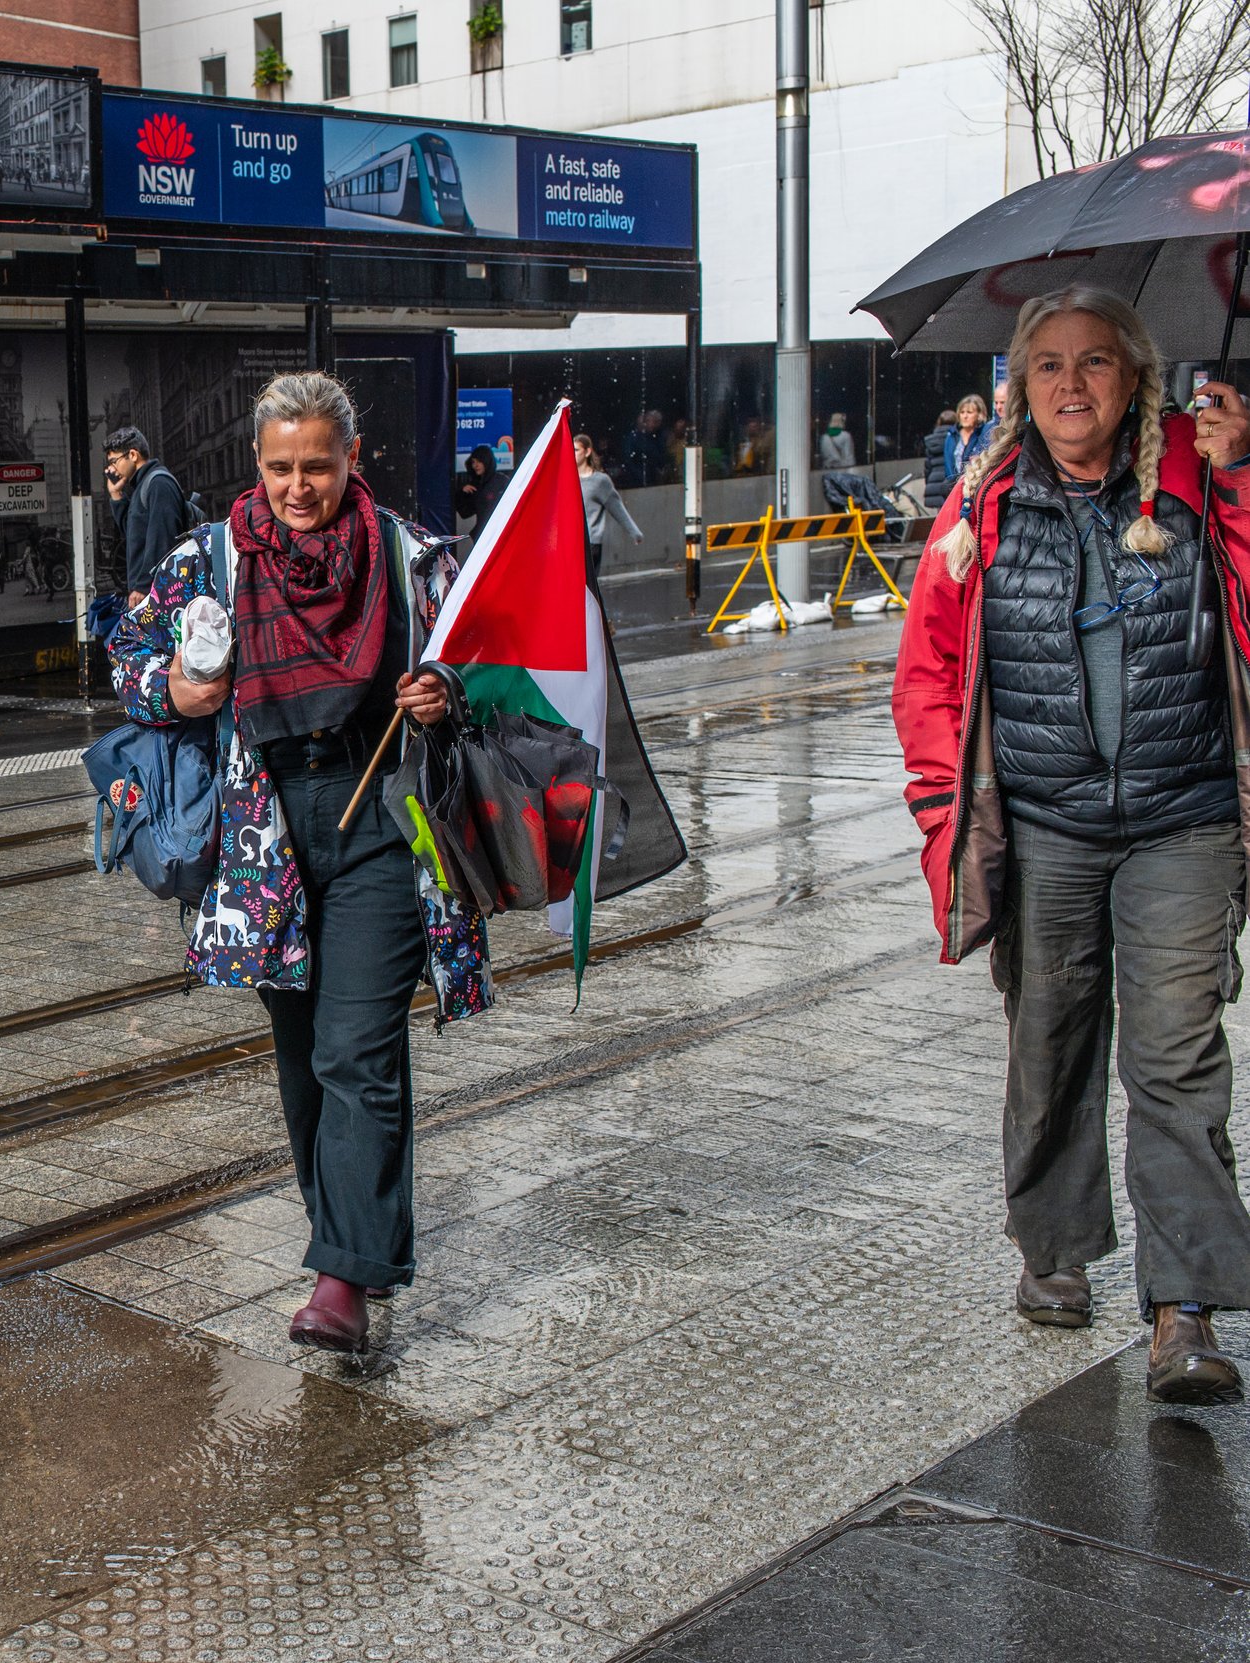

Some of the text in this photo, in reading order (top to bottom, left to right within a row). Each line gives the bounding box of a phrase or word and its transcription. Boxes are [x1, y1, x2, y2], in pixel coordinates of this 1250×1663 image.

[231, 124, 298, 155] Turn up
[233, 156, 292, 184] and go
[545, 154, 620, 179] A fast, safe
[138, 164, 195, 196] NSW
[139, 193, 196, 207] GOVERNMENT
[545, 181, 624, 204] and reliable
[545, 208, 635, 234] metro railway
[461, 418, 472, 429] 612
[473, 418, 485, 429] 173
[3, 468, 37, 479] DANGER
[8, 485, 33, 498] DEEP
